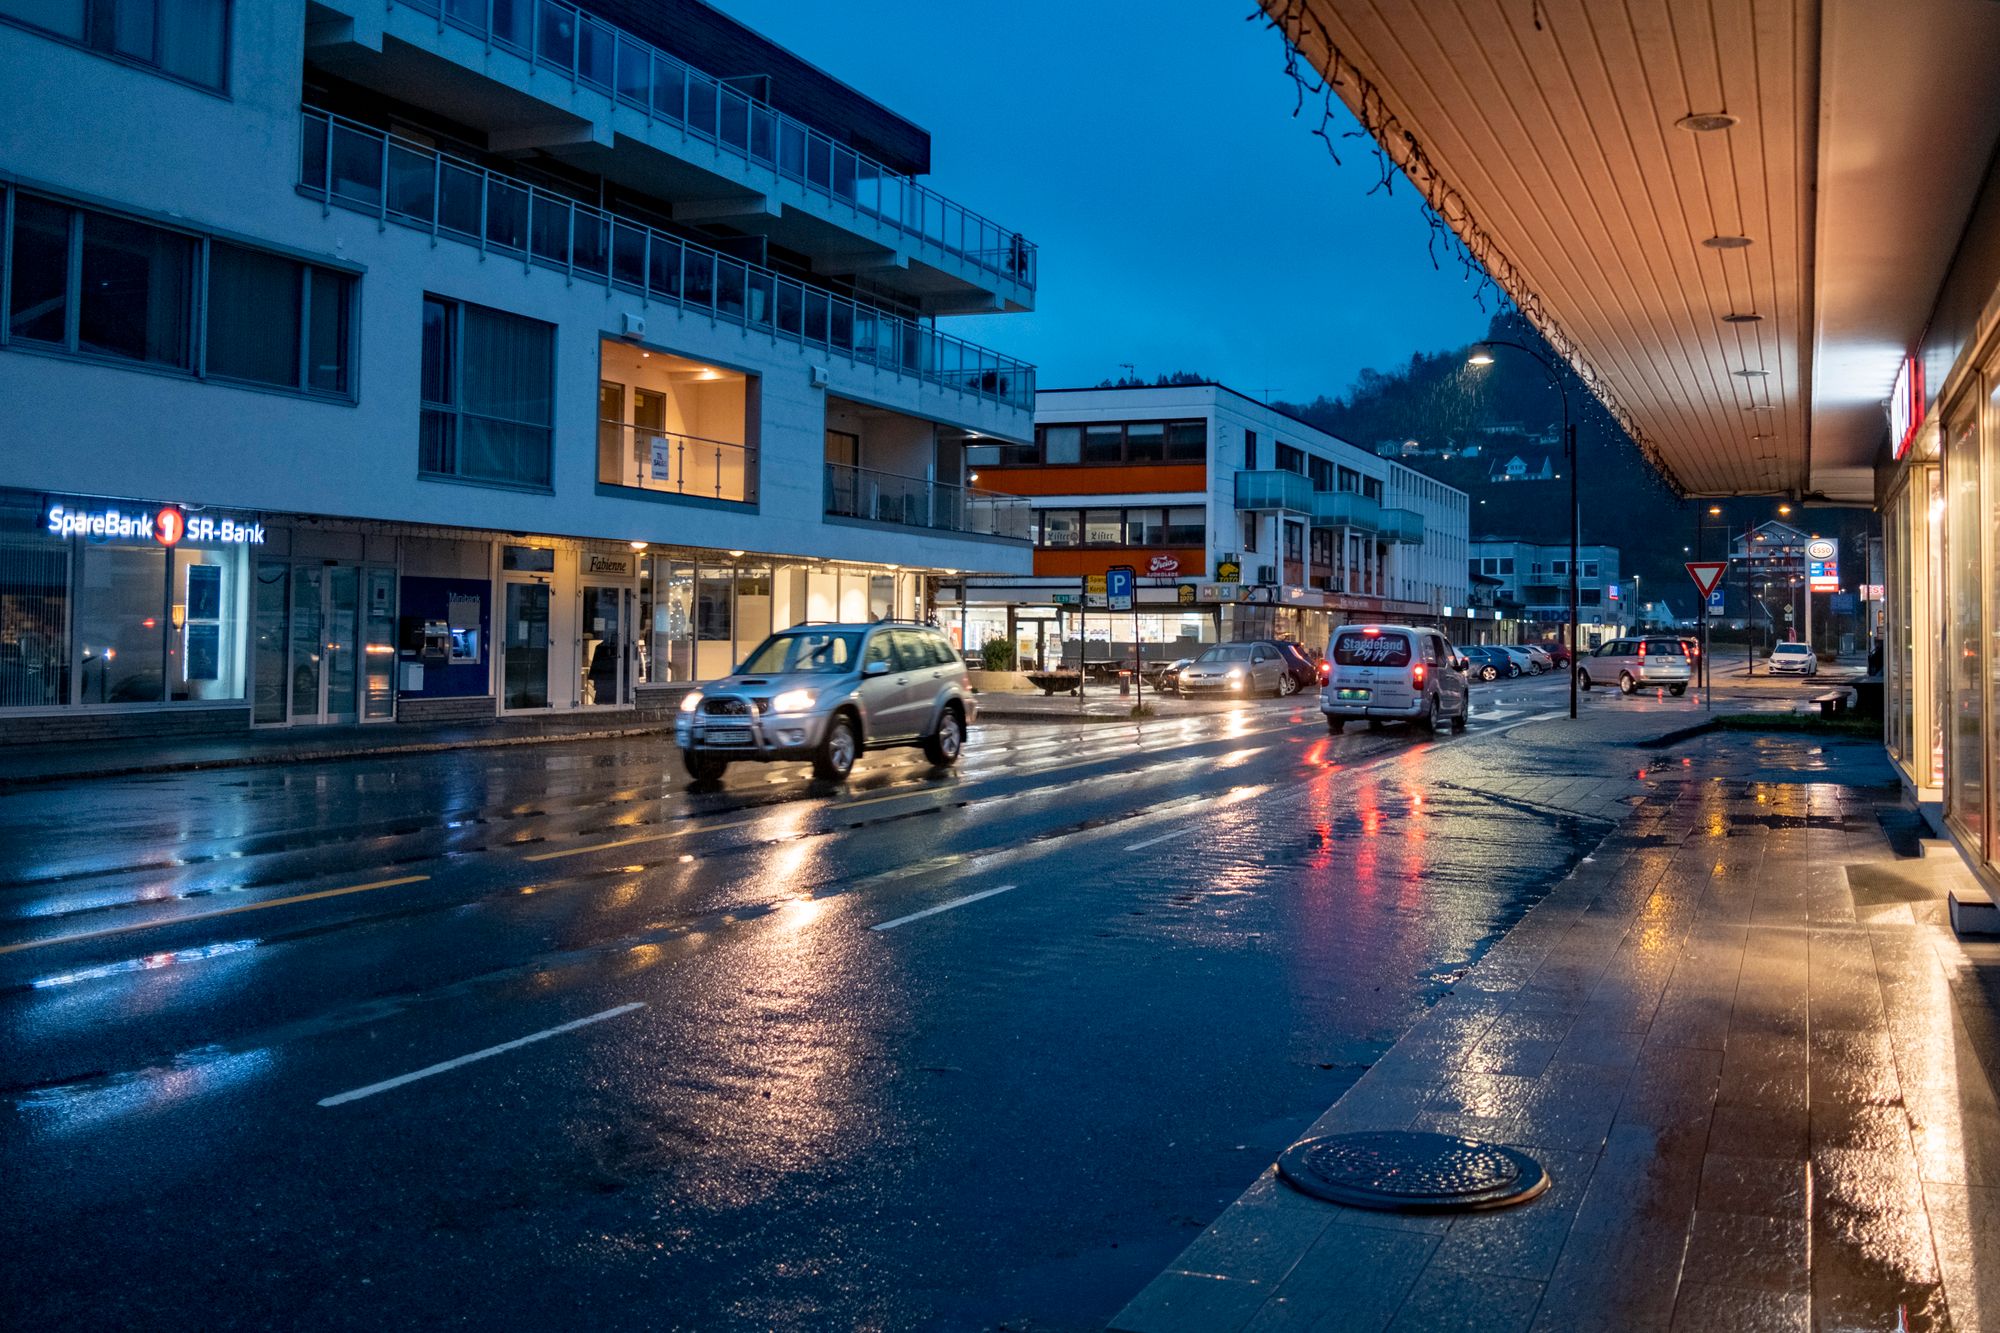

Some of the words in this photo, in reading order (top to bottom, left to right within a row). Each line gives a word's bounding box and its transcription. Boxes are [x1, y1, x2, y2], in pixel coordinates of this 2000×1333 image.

[49, 506, 153, 540] SpareBank
[187, 519, 265, 544] SR-Bank
[590, 556, 627, 573] Fabienne
[1150, 556, 1179, 571] Freia
[1114, 575, 1126, 594] P
[1204, 588, 1229, 596] MIX
[449, 592, 480, 603] Minibank
[1711, 592, 1720, 604] P
